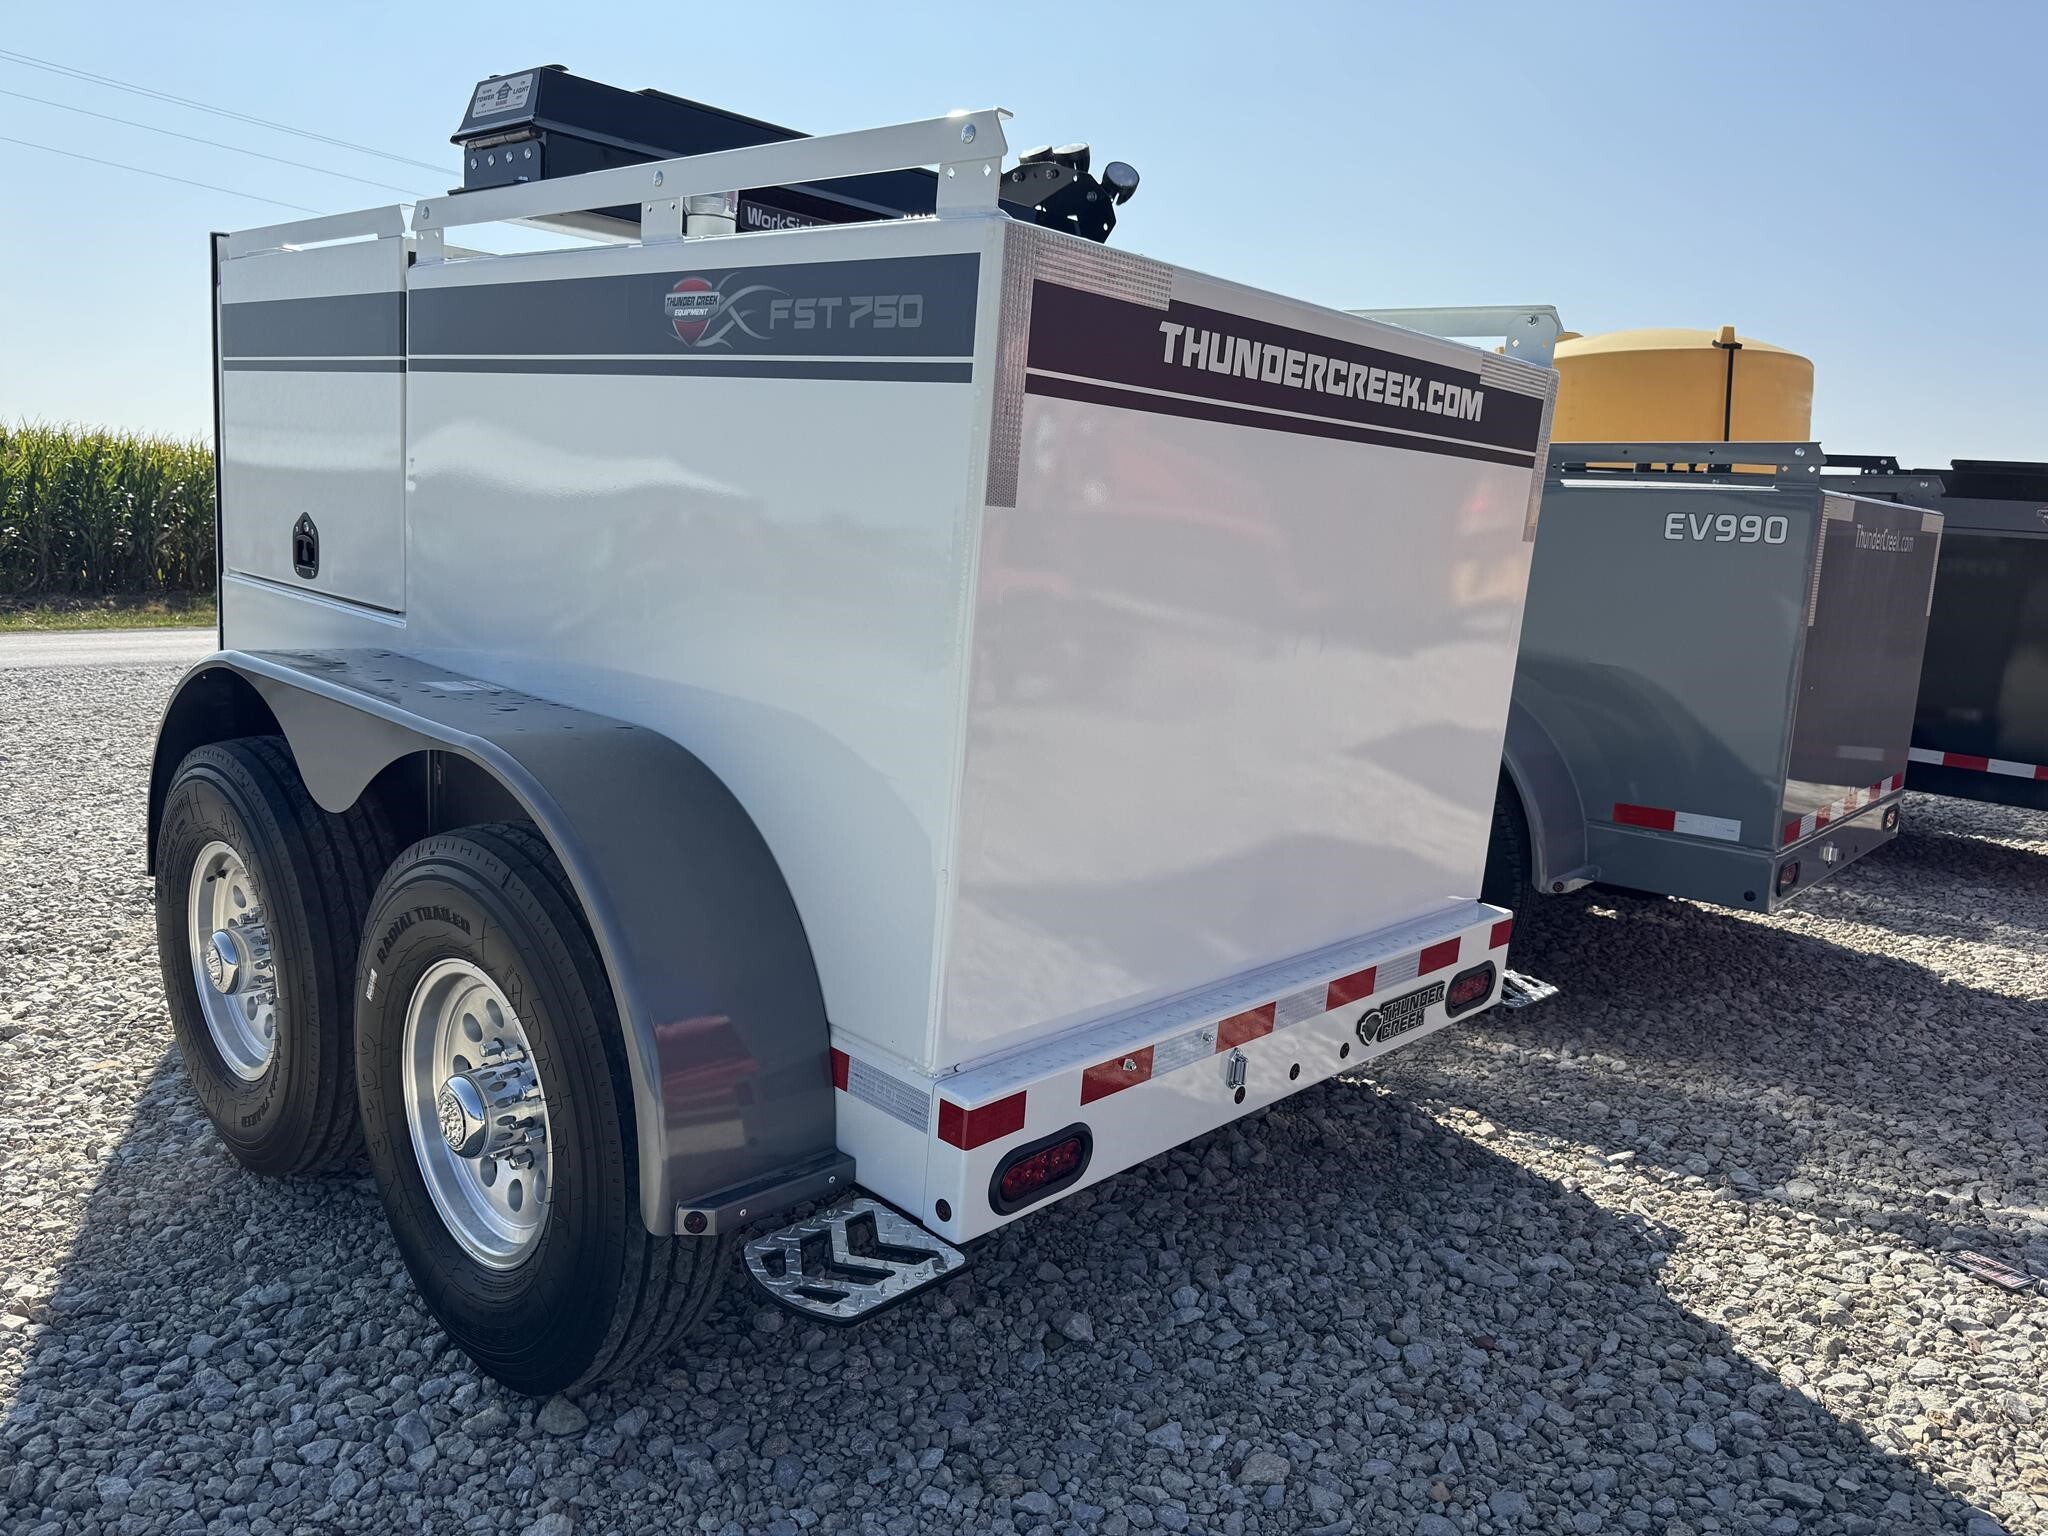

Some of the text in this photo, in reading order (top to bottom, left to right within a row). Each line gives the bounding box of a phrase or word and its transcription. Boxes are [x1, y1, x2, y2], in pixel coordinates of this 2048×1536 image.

[747, 206, 812, 230] WorkSi
[666, 295, 718, 307] THUNDER CREEK
[674, 308, 708, 316] EQUIPMENT
[769, 294, 923, 330] FST 750
[1158, 320, 1485, 423] THUNDERCREEK.COM
[1664, 512, 1789, 545] EV990
[376, 905, 471, 965] RADIAL TRAILER
[1381, 982, 1445, 1041] THUNDER CREEK
